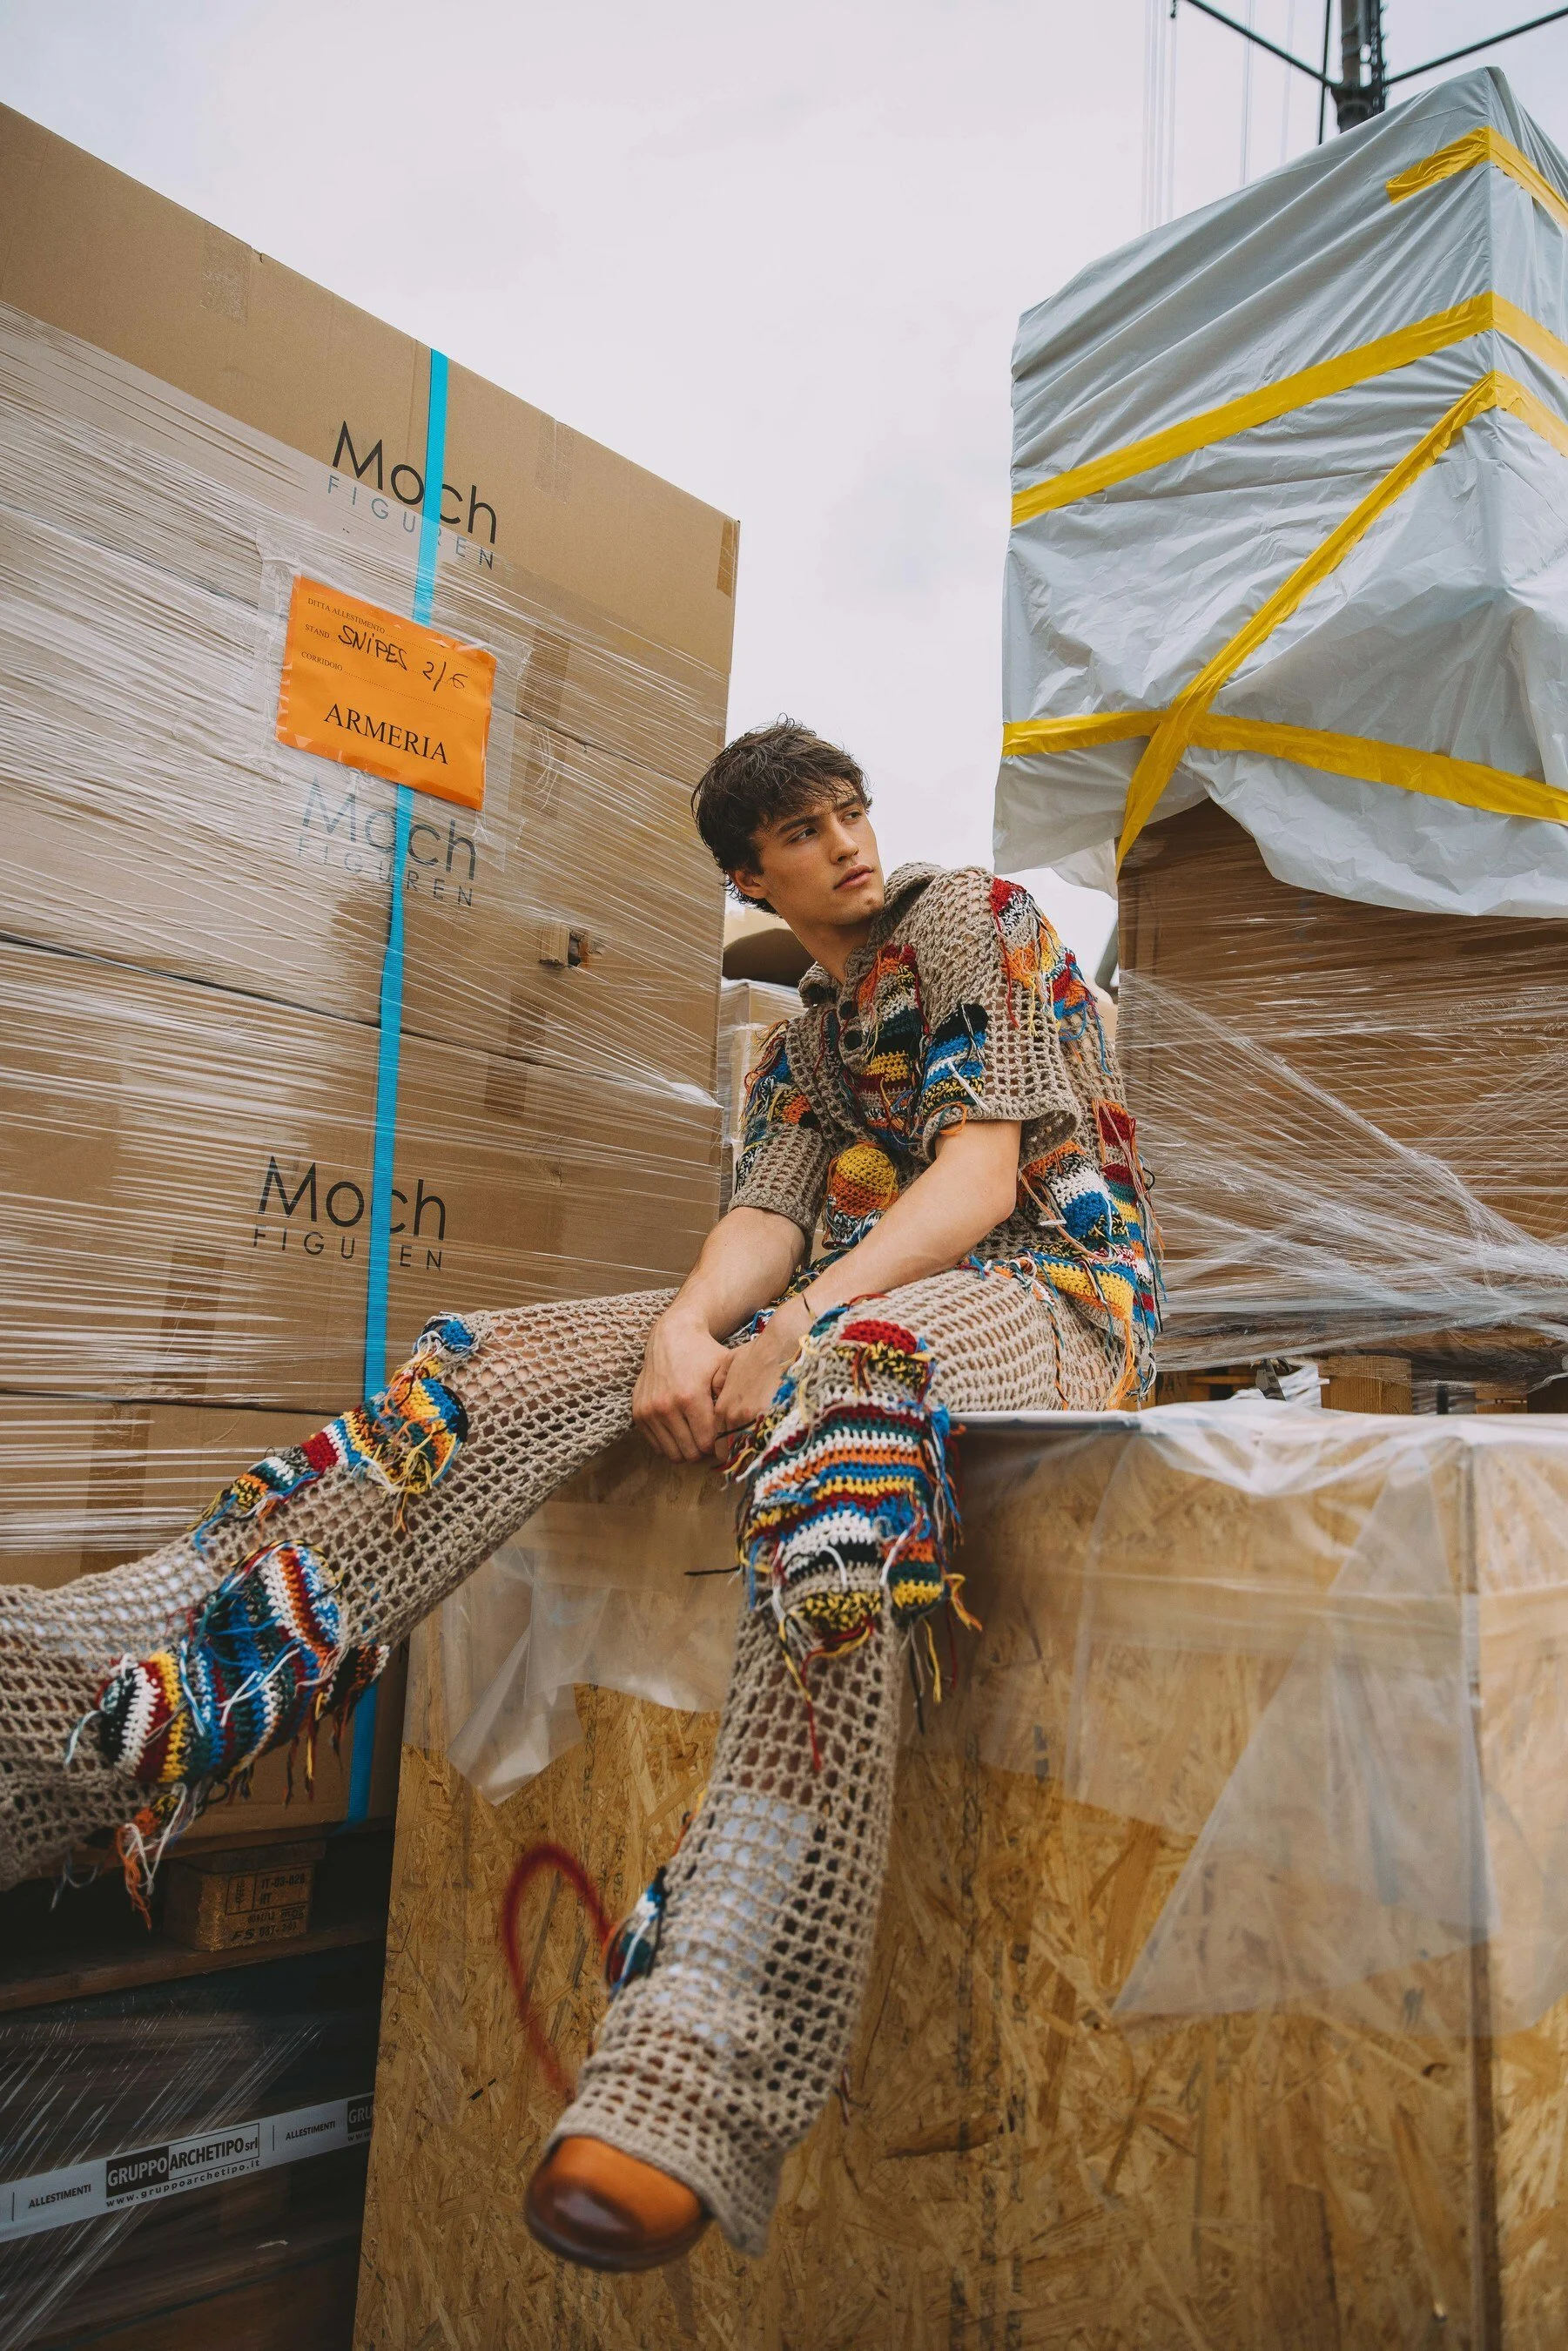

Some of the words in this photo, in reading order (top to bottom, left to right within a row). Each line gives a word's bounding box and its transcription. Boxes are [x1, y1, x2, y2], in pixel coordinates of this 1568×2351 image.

[305, 623, 330, 639] STAND
[307, 597, 331, 612] DITTA
[332, 608, 386, 634] ALLESTIMENTO
[301, 651, 343, 671] CORRIDOIO
[324, 704, 448, 765] ARMERIA
[302, 774, 476, 880] Moch
[253, 1224, 442, 1271] FIGUEN
[286, 2121, 336, 2141] ALLESTIMENTI
[107, 2157, 168, 2187] GRUPPO
[169, 2137, 245, 2172] ARCHETIPO
[28, 2184, 91, 2209] ALLESTIMENTI
[106, 2159, 260, 2208] www.gruppoarchetipo.it
